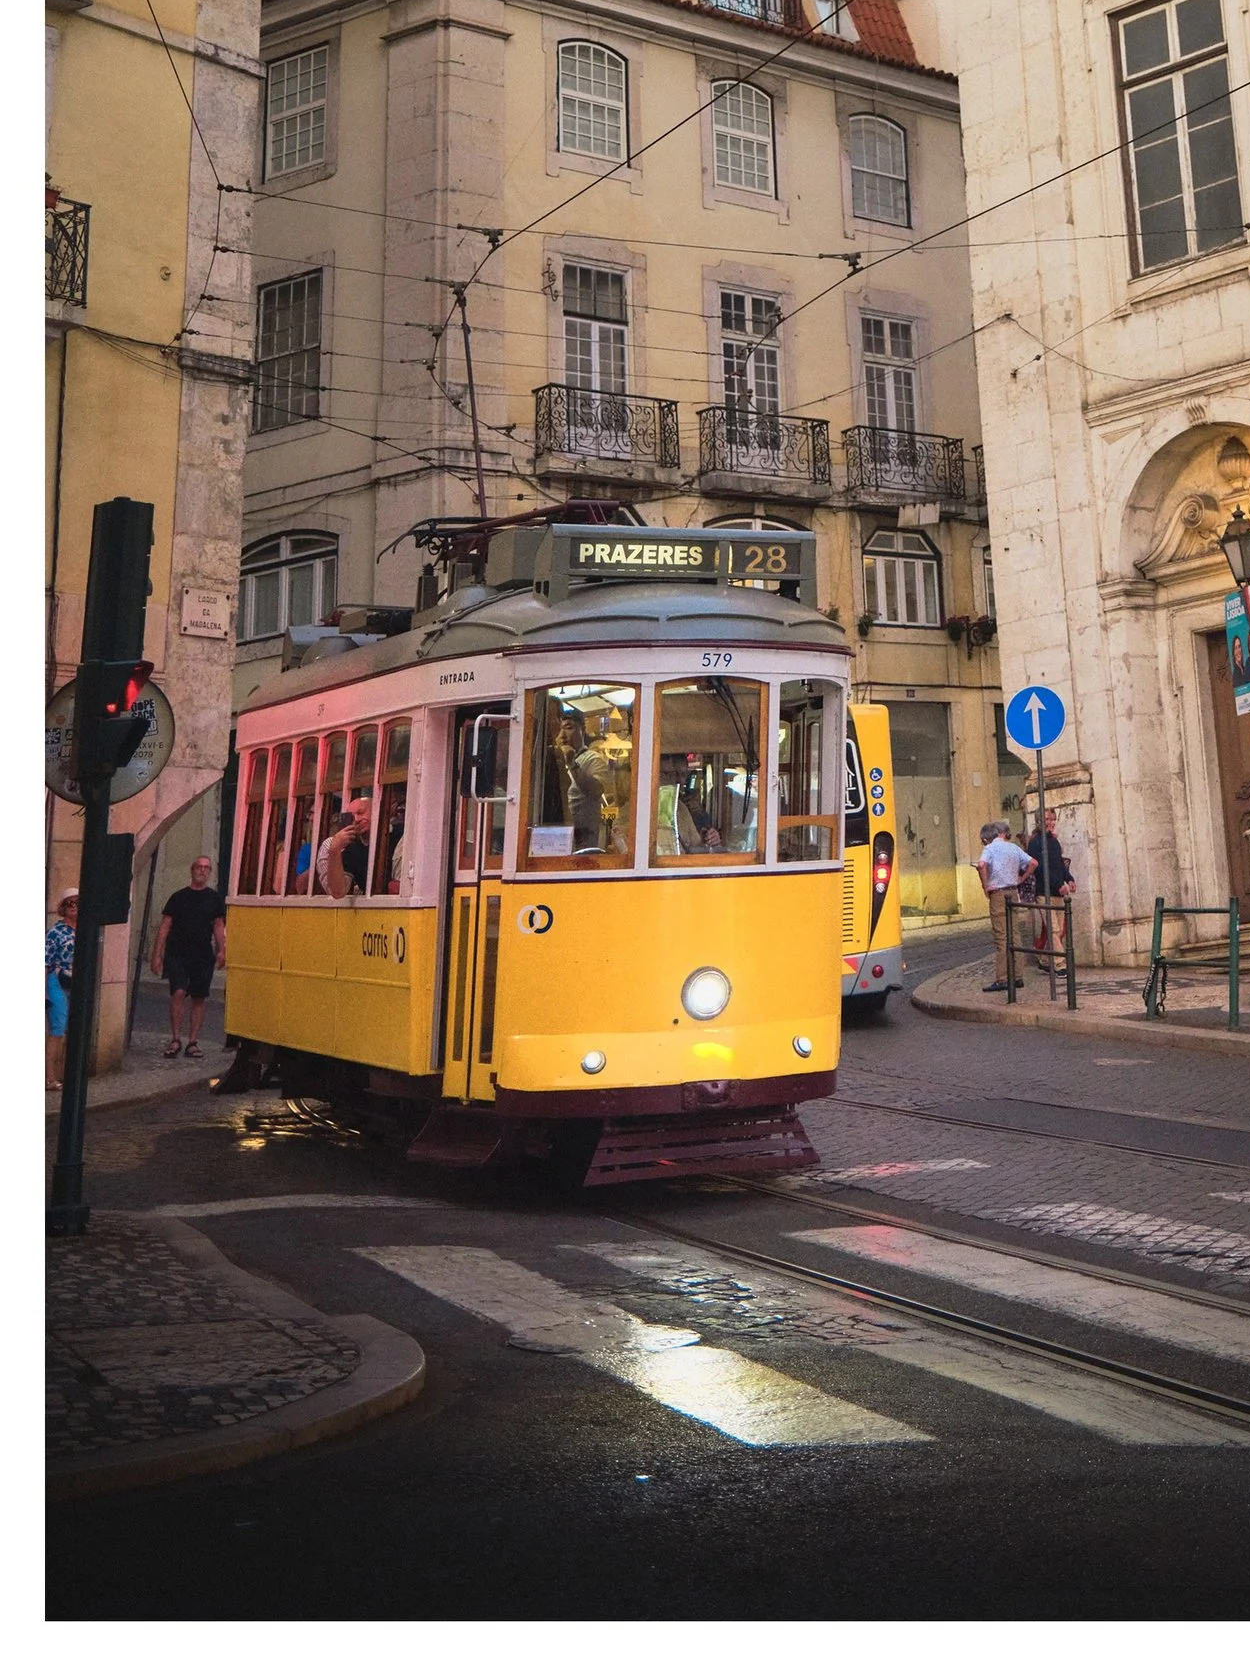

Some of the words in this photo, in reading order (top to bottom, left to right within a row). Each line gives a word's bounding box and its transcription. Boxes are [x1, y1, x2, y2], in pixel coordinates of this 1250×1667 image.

[579, 543, 703, 566] PRAZERES
[744, 544, 787, 573] 28
[701, 652, 732, 667] 579
[440, 671, 474, 685] ENTRADA
[362, 924, 388, 959] carris
